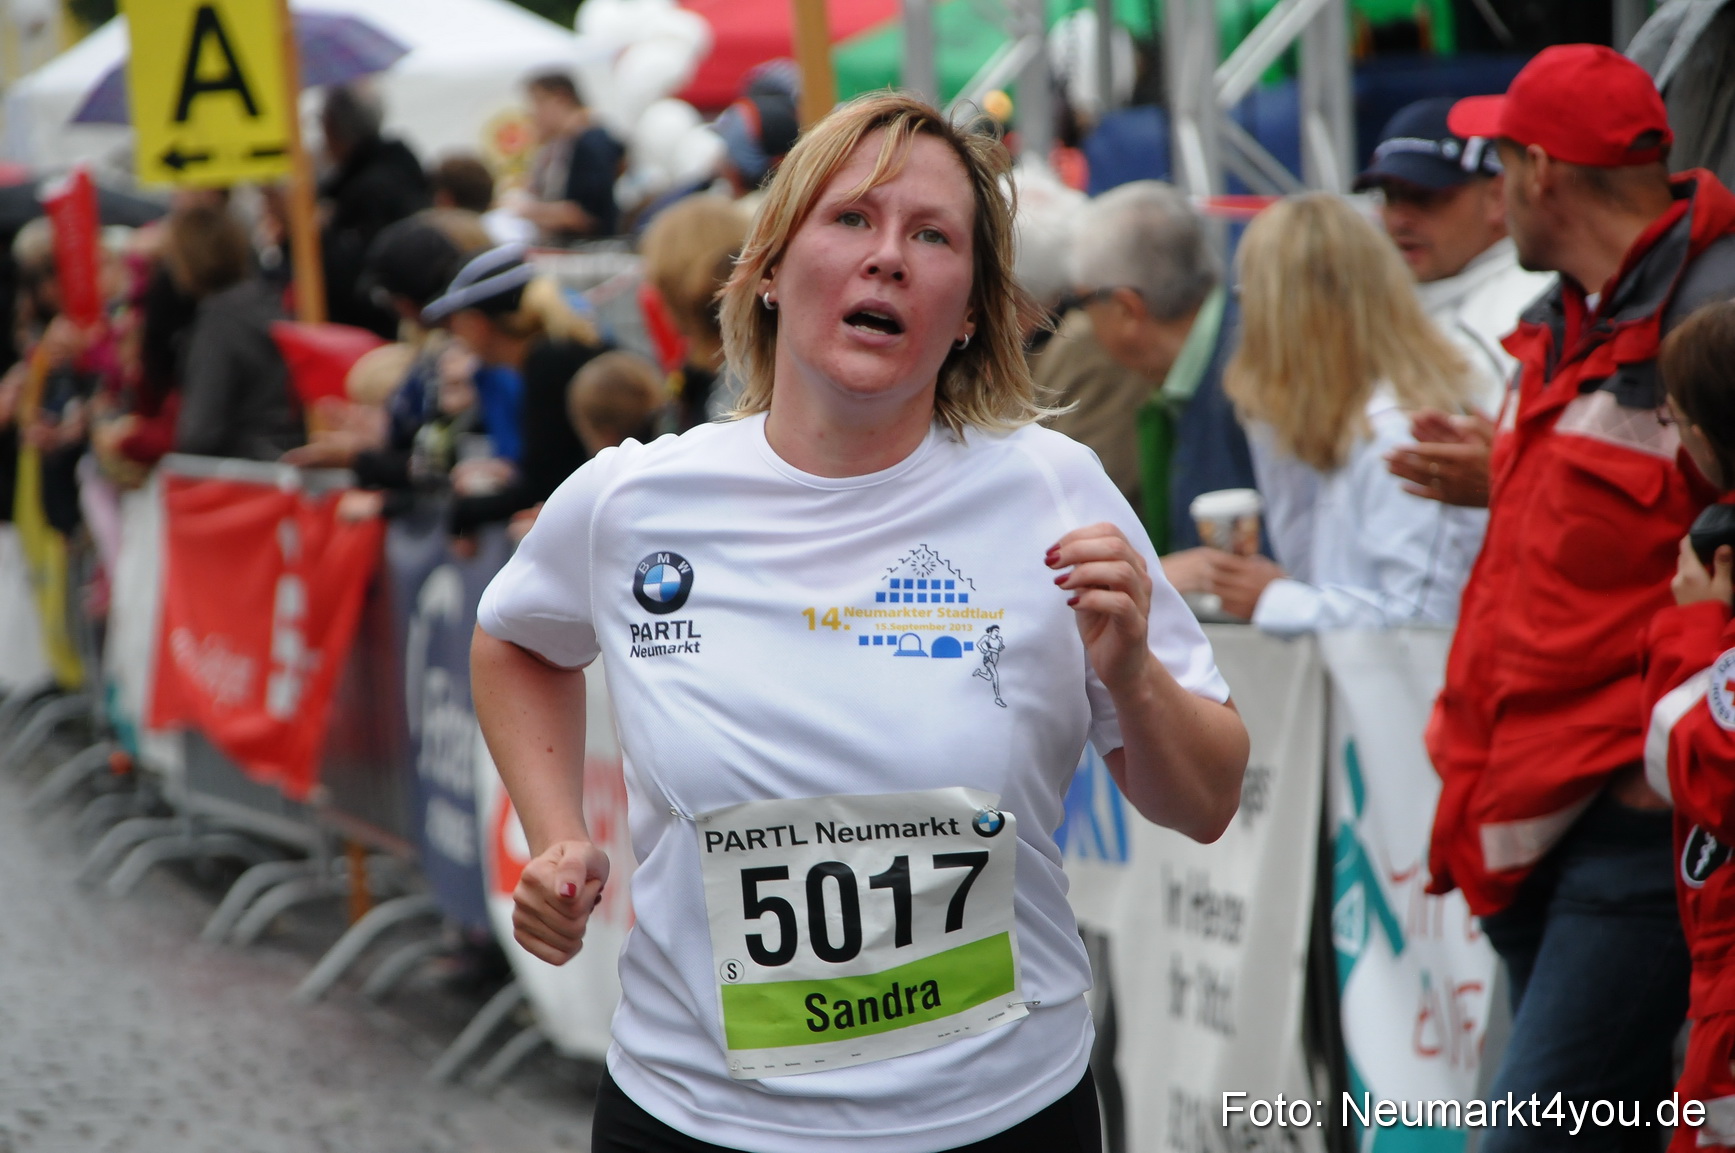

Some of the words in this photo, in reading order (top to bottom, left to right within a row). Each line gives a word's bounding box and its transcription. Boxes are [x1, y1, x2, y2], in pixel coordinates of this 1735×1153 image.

[174, 5, 259, 123] A
[638, 552, 691, 575] BMW
[802, 607, 851, 631] 14.
[844, 606, 933, 619] Neumarkter
[937, 607, 1005, 620] Stadtlauf
[949, 623, 974, 632] 2013
[629, 620, 702, 643] PARTL
[629, 640, 701, 658] Neumarkt
[704, 824, 808, 853] PARTL
[815, 816, 961, 845] Neumarkt
[740, 850, 989, 968] 5017
[726, 962, 738, 981] S
[804, 978, 942, 1033] Sandra
